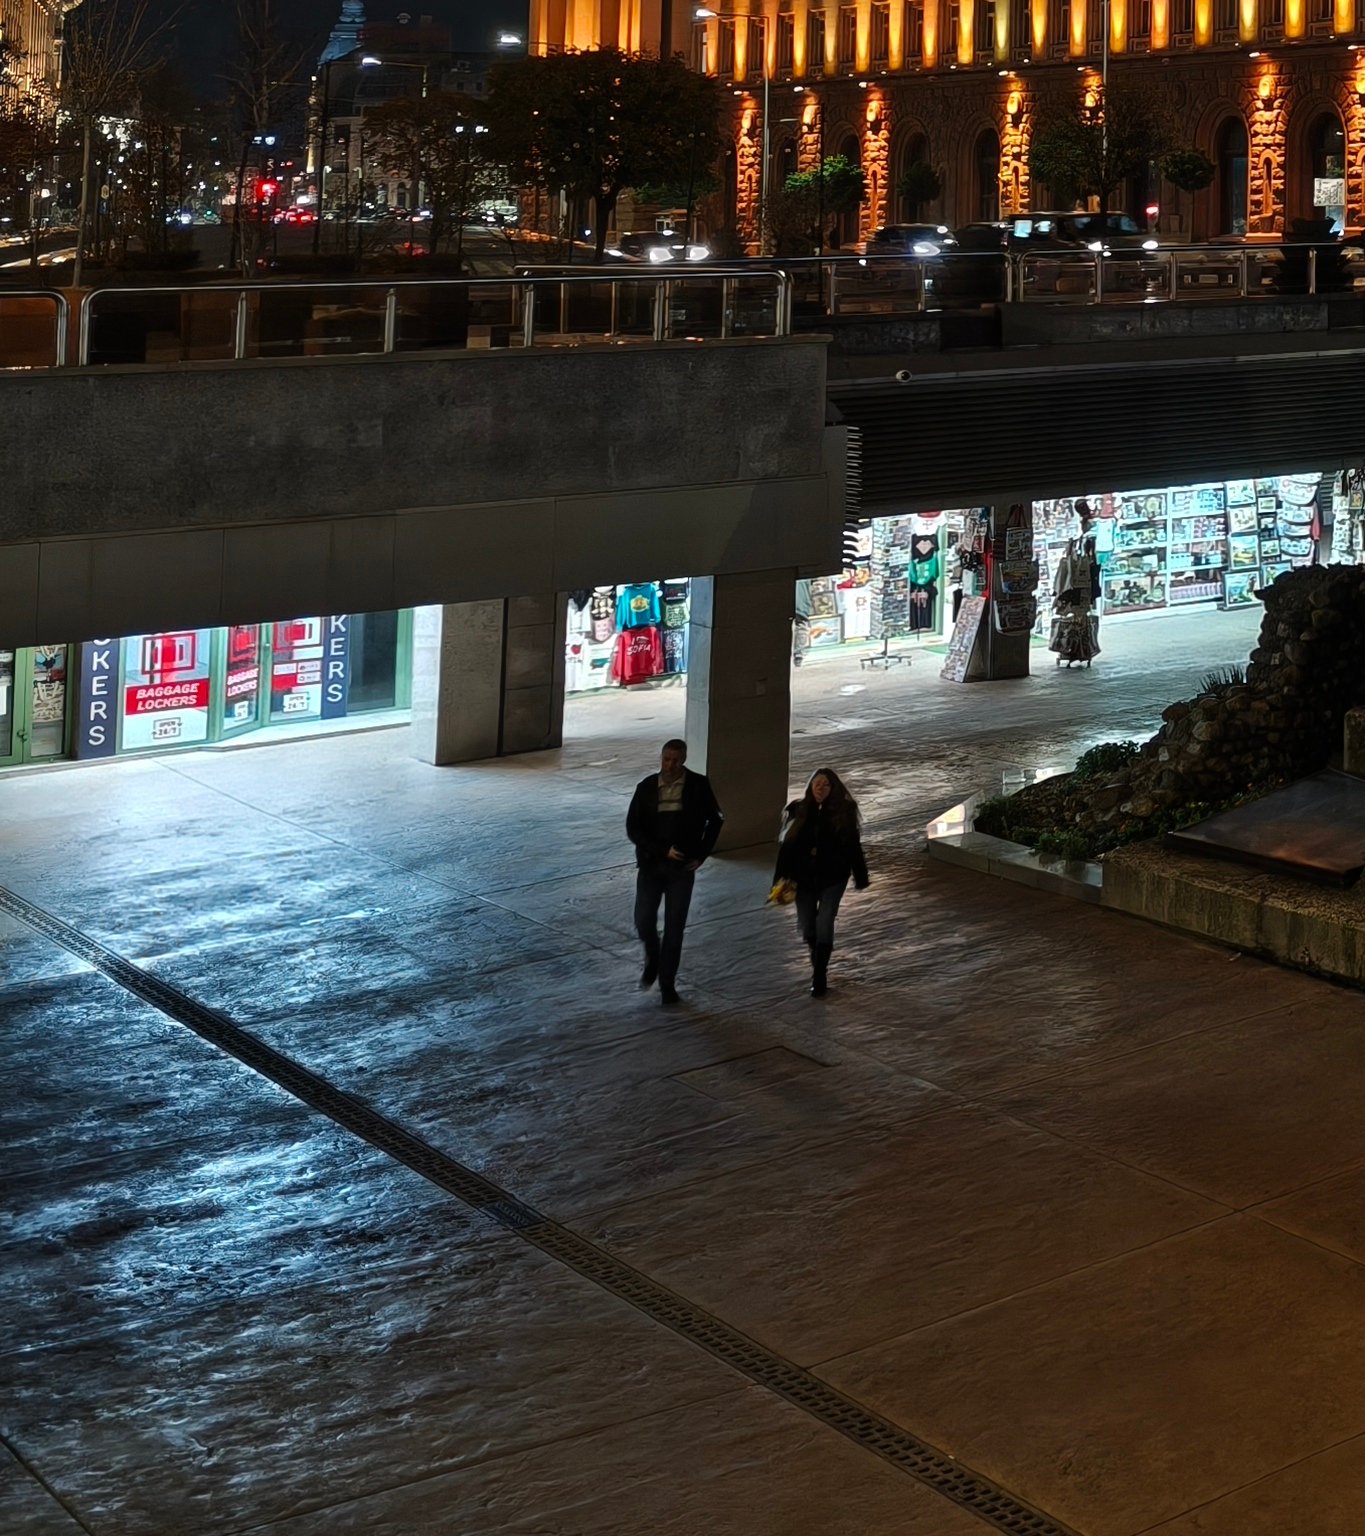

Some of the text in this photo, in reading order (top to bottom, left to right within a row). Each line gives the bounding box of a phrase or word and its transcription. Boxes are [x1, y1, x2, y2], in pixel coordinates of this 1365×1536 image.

[135, 683, 200, 699] BAGGAGE
[137, 695, 198, 711] LOCKERS
[159, 720, 176, 728] OPEN
